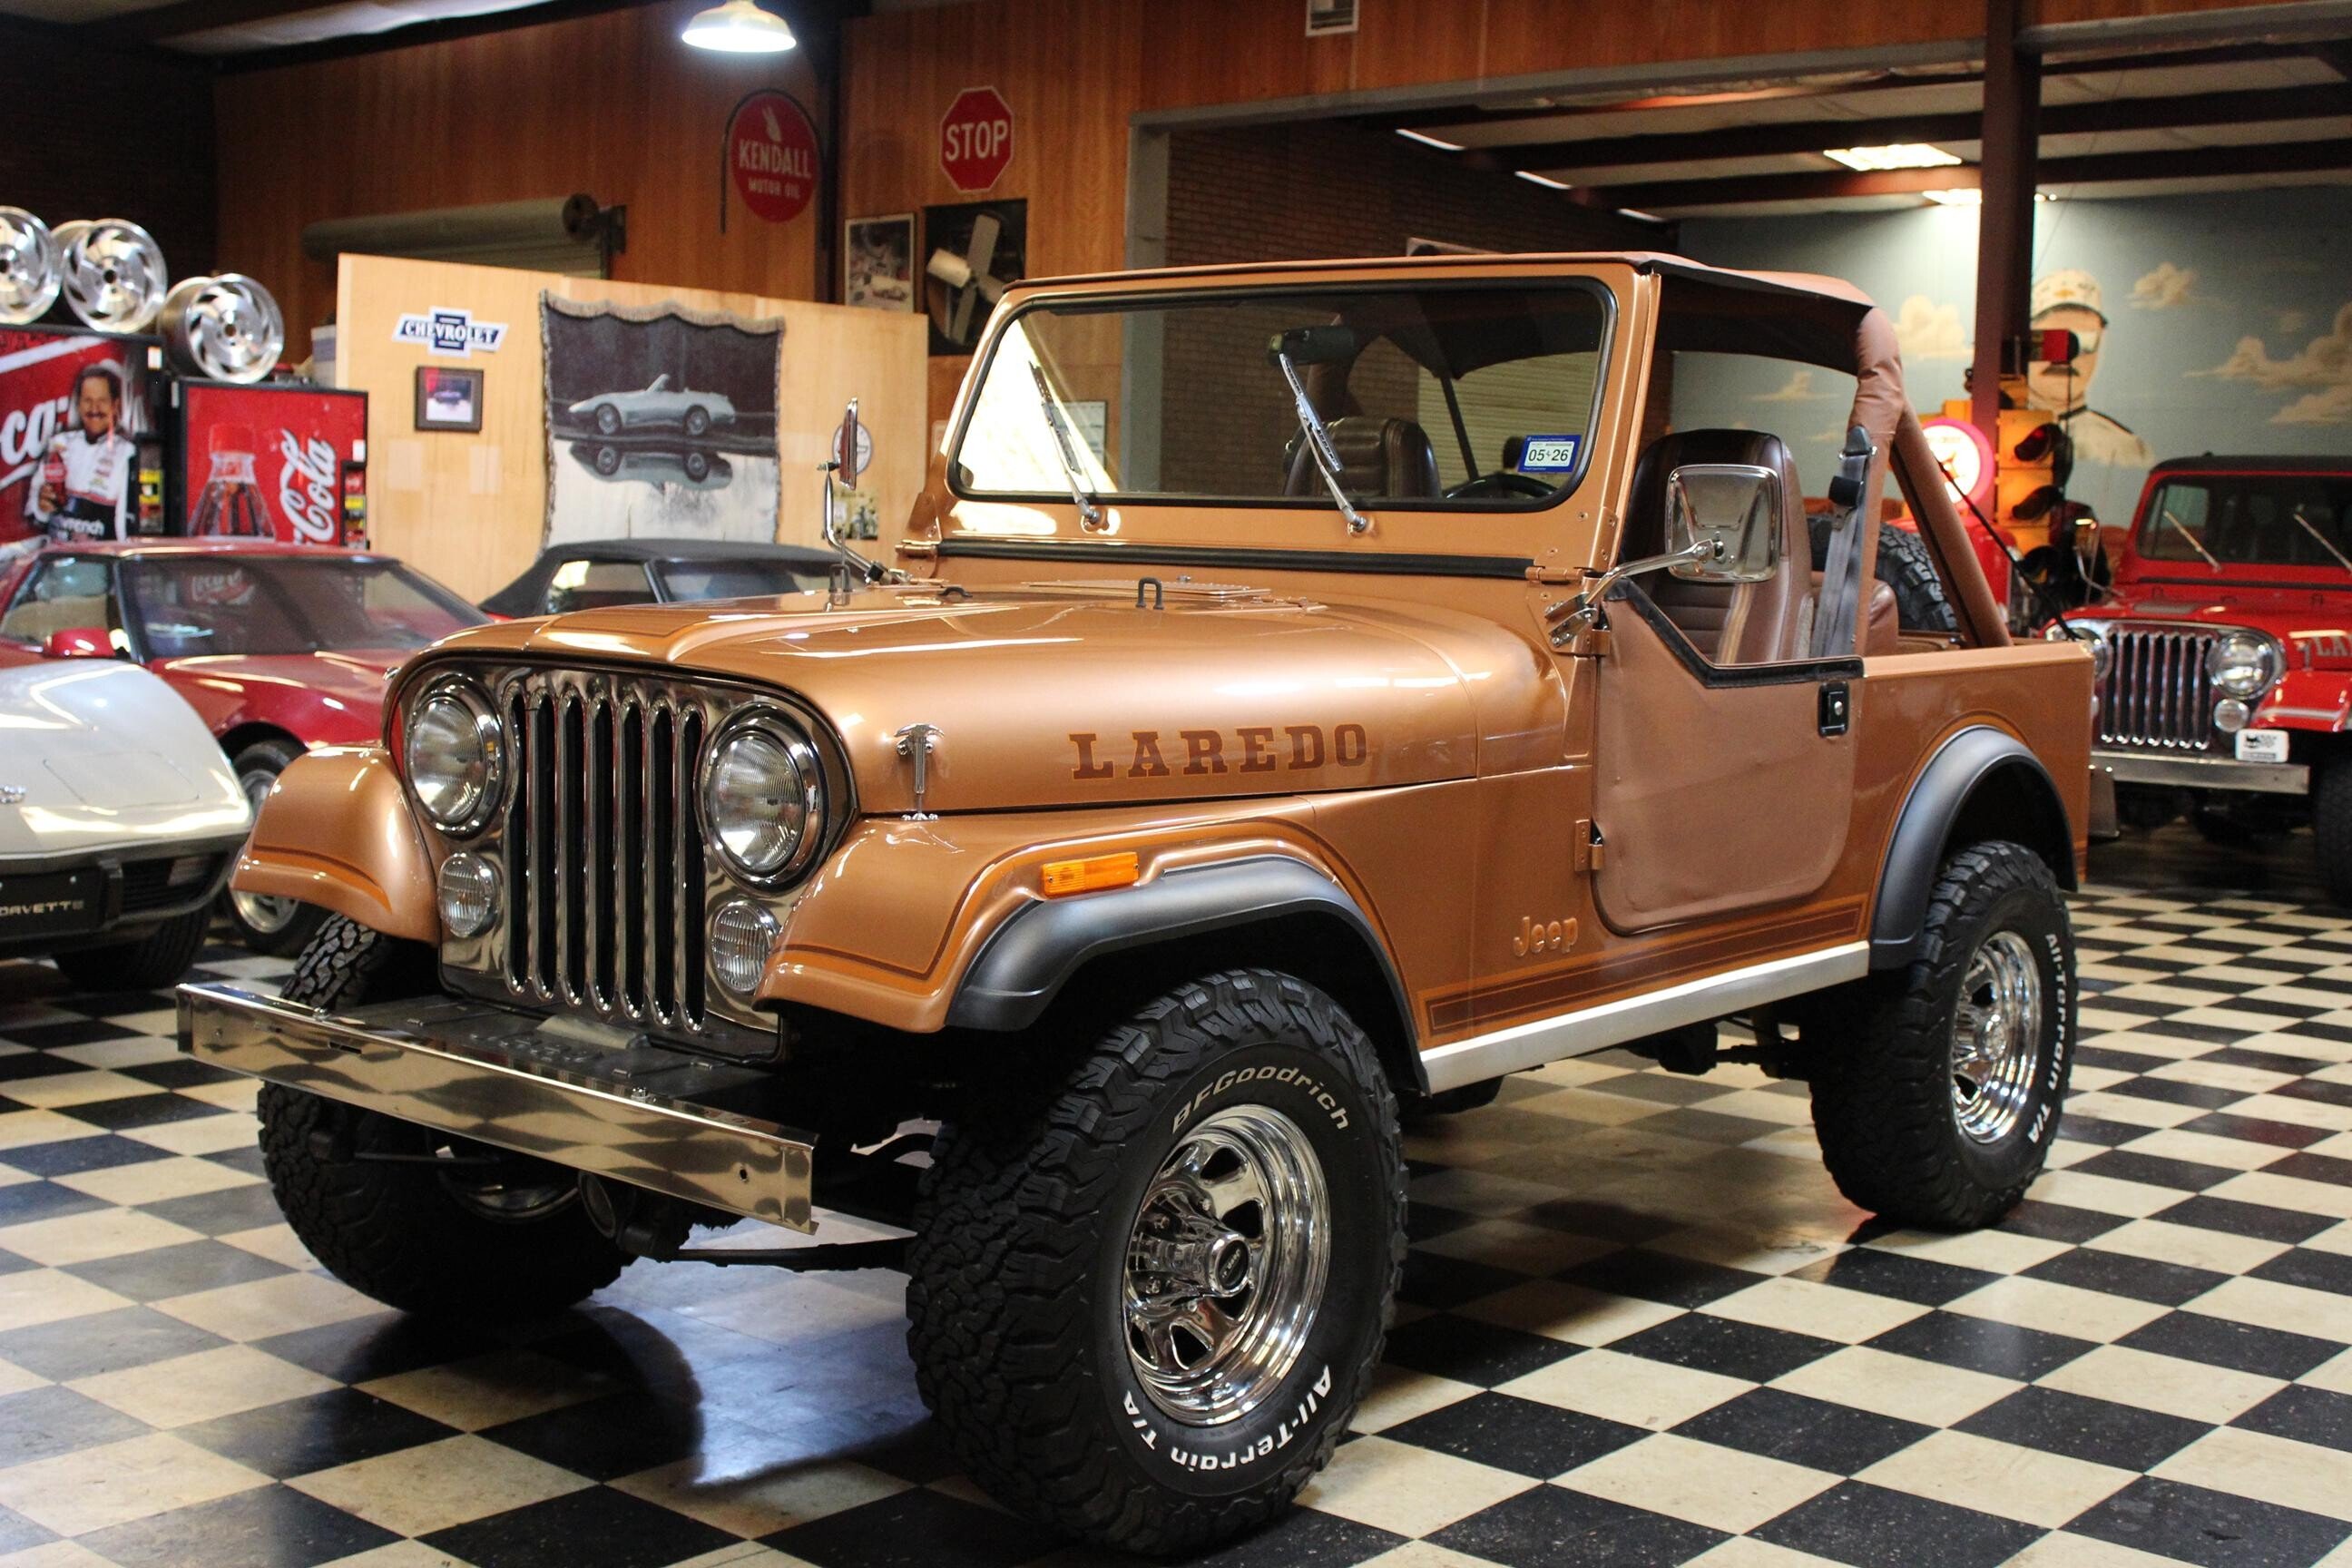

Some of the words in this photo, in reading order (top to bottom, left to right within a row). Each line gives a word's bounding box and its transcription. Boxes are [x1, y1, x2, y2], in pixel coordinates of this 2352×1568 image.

[739, 139, 812, 180] KENDALL
[946, 120, 1008, 162] STOP
[748, 177, 780, 196] MOTOR
[784, 182, 800, 199] OIL
[404, 320, 495, 344] CHEVROLET
[1528, 448, 1546, 462] 05
[1551, 448, 1569, 462] 26
[1068, 723, 1367, 780] LAREDO
[1513, 916, 1579, 957] Jeep
[2045, 933, 2067, 1091] All-Terrain
[1172, 1065, 1350, 1134] BFGoodrich
[2027, 1102, 2052, 1143] T/A
[1122, 1389, 1158, 1450] T/A
[1170, 1364, 1332, 1473] All-Terrain
